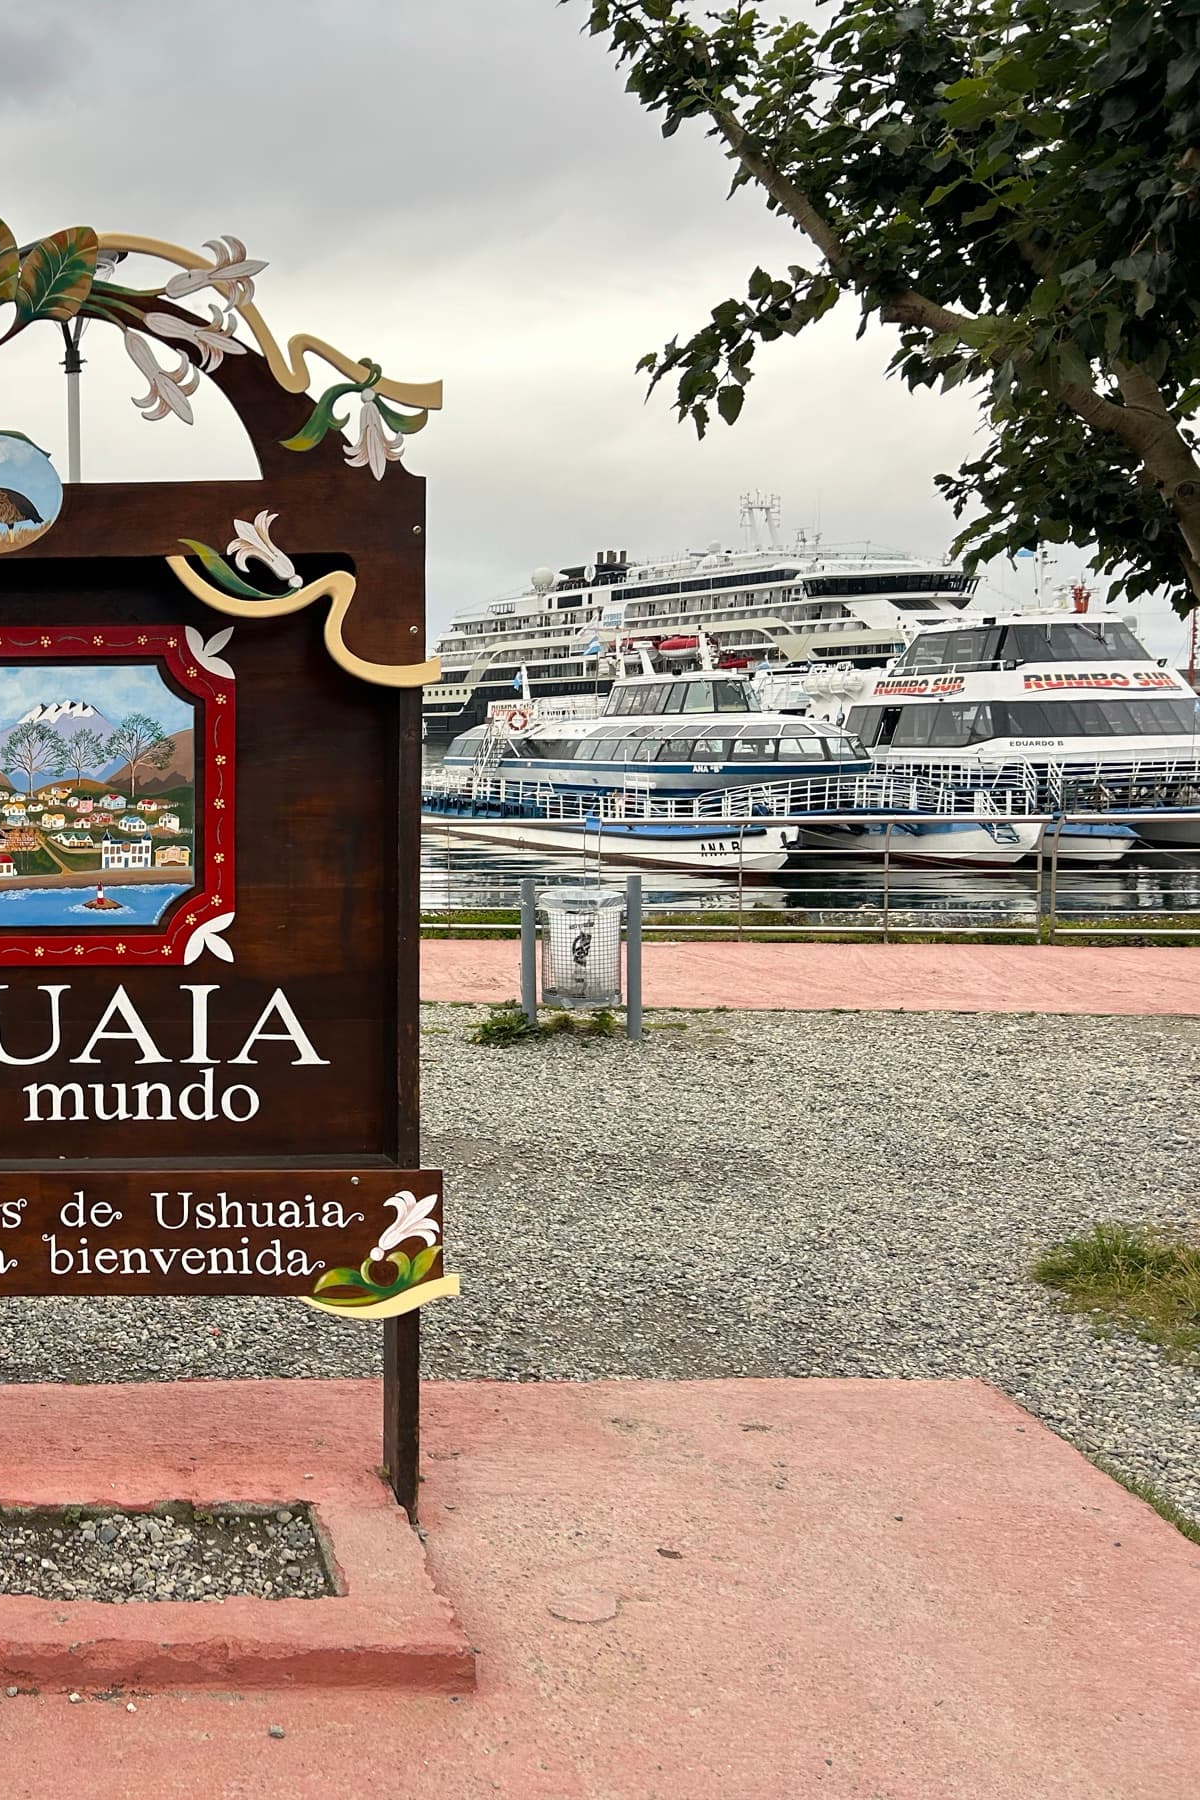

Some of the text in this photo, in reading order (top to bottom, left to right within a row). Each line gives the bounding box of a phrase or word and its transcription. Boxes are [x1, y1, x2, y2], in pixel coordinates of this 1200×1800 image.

[873, 676, 965, 695] RUMBO SUR
[1023, 672, 1177, 689] RUMBO SUR
[692, 765, 709, 773] ANA
[700, 842, 728, 857] ANA
[22, 1067, 260, 1122] mundo
[60, 1190, 123, 1228] de
[150, 1191, 365, 1230] Ushuaia
[41, 1233, 326, 1277] bienvenida
